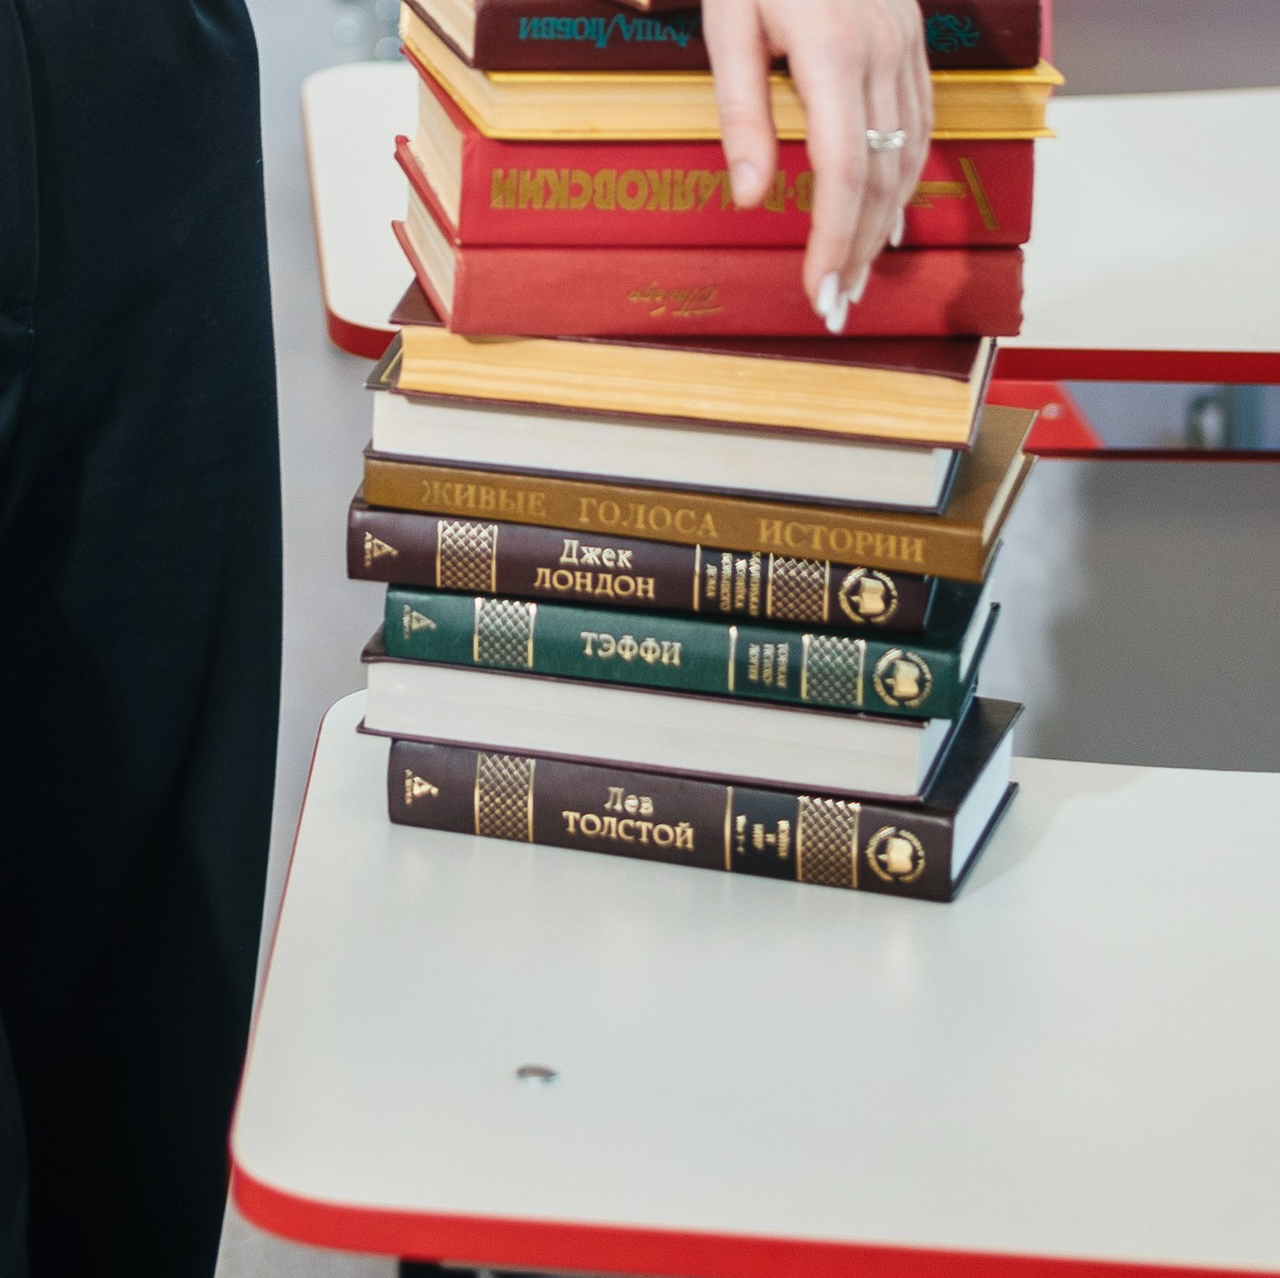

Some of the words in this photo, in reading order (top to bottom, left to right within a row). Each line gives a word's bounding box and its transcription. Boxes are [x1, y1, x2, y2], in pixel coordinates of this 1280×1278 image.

[421, 480, 546, 517] ЖИВЫЕ
[578, 496, 717, 538] ГОЛОСА
[758, 518, 927, 563] ИСТОРИИ
[559, 539, 633, 569] Джек
[533, 567, 656, 600] ЛОНДОН
[580, 631, 682, 668] ТЭФФИ
[604, 786, 655, 816] Лев
[562, 810, 696, 851] ТОЛСТОЙ
